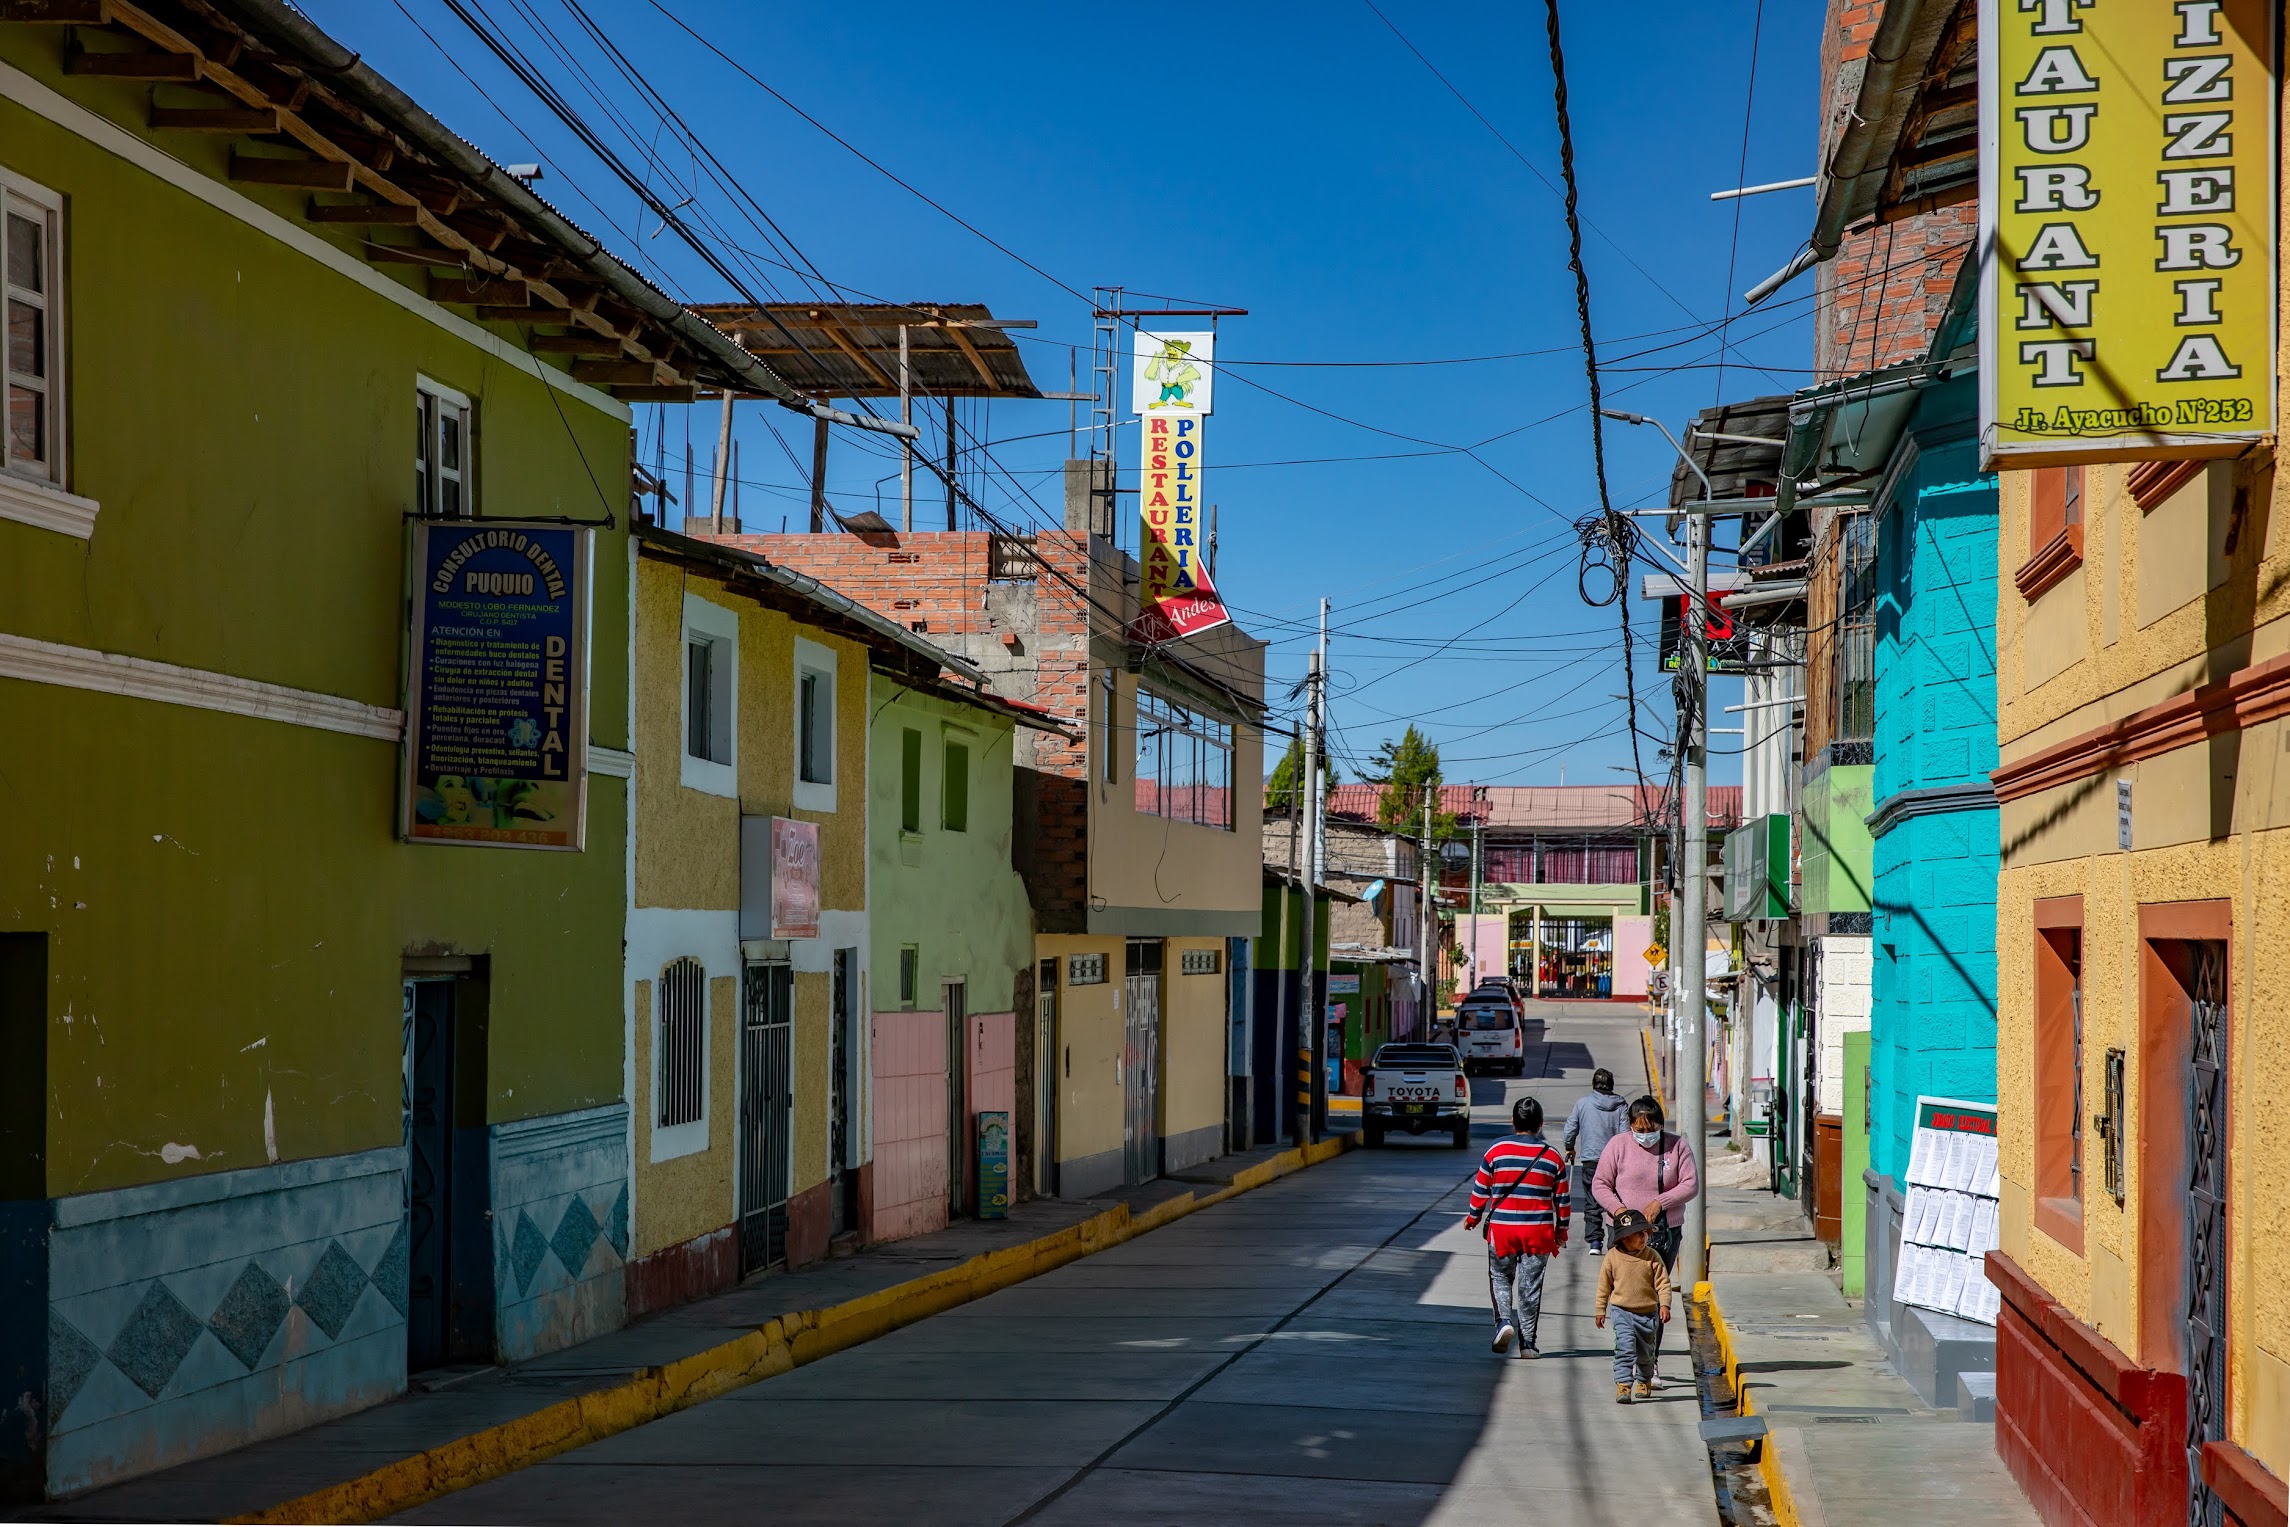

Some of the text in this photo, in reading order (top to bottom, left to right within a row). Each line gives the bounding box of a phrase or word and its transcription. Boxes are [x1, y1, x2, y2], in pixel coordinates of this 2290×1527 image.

[2014, 0, 2101, 388] TAURANT
[2154, 0, 2243, 383] IZZERIA
[2015, 407, 2048, 432] Jr.
[2053, 402, 2172, 435] Ayacucho
[1150, 419, 1169, 598] RESTAURANT
[1174, 419, 1194, 587] POLLERIA
[432, 530, 566, 600] CONSULTORIO DENTAL
[466, 572, 534, 596] PUQUIO
[438, 601, 560, 612] MODESTO LOBO FERNANDEZ
[1170, 596, 1216, 627] Andes
[486, 641, 530, 650] tratamiento
[530, 642, 541, 650] de
[435, 648, 540, 659] enfermedades buco dentales
[434, 657, 476, 666] Curaciones
[478, 659, 492, 667] con
[493, 659, 504, 667] luz
[462, 667, 472, 675] de
[514, 668, 538, 678] dental
[433, 676, 445, 684] sin
[446, 676, 466, 684] dolor
[507, 679, 534, 688] adultos
[433, 685, 474, 694] Endodoncia
[486, 687, 508, 696] piezas
[509, 688, 540, 697] dentales
[433, 694, 471, 702] anteriores
[478, 696, 520, 705] posteriores
[542, 636, 566, 775] DENTAL
[487, 708, 497, 716] en
[432, 714, 458, 723] totales
[466, 716, 501, 725] parciales
[431, 724, 462, 734] Puentes
[463, 725, 480, 735] fijos
[473, 735, 506, 744] duracast
[477, 755, 537, 767] blanqueamiento
[430, 765, 472, 774] Destartraje
[479, 766, 515, 775] Profilaxis
[788, 828, 805, 866] Zoe
[1387, 1087, 1441, 1096] TOYOTA
